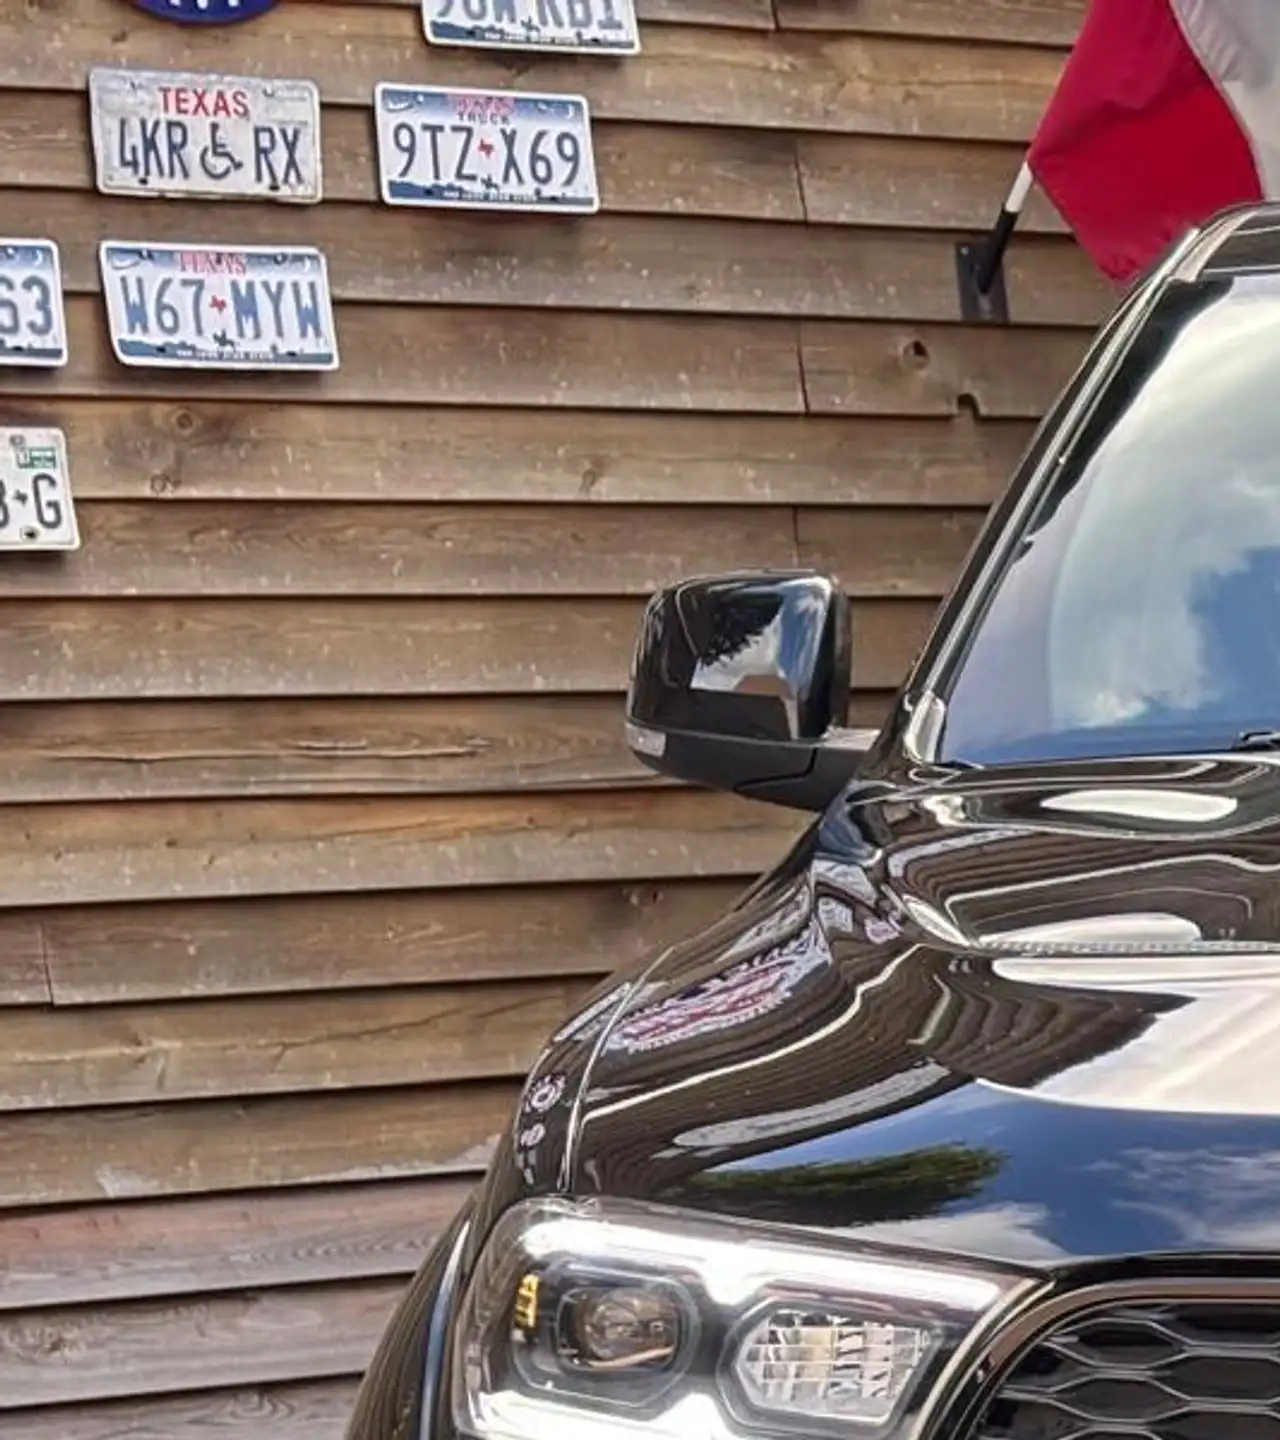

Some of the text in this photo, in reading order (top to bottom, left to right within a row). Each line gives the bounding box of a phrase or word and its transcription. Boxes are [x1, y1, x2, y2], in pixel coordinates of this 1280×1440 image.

[158, 86, 249, 120] TEXAS
[119, 118, 304, 185] 4KR RX
